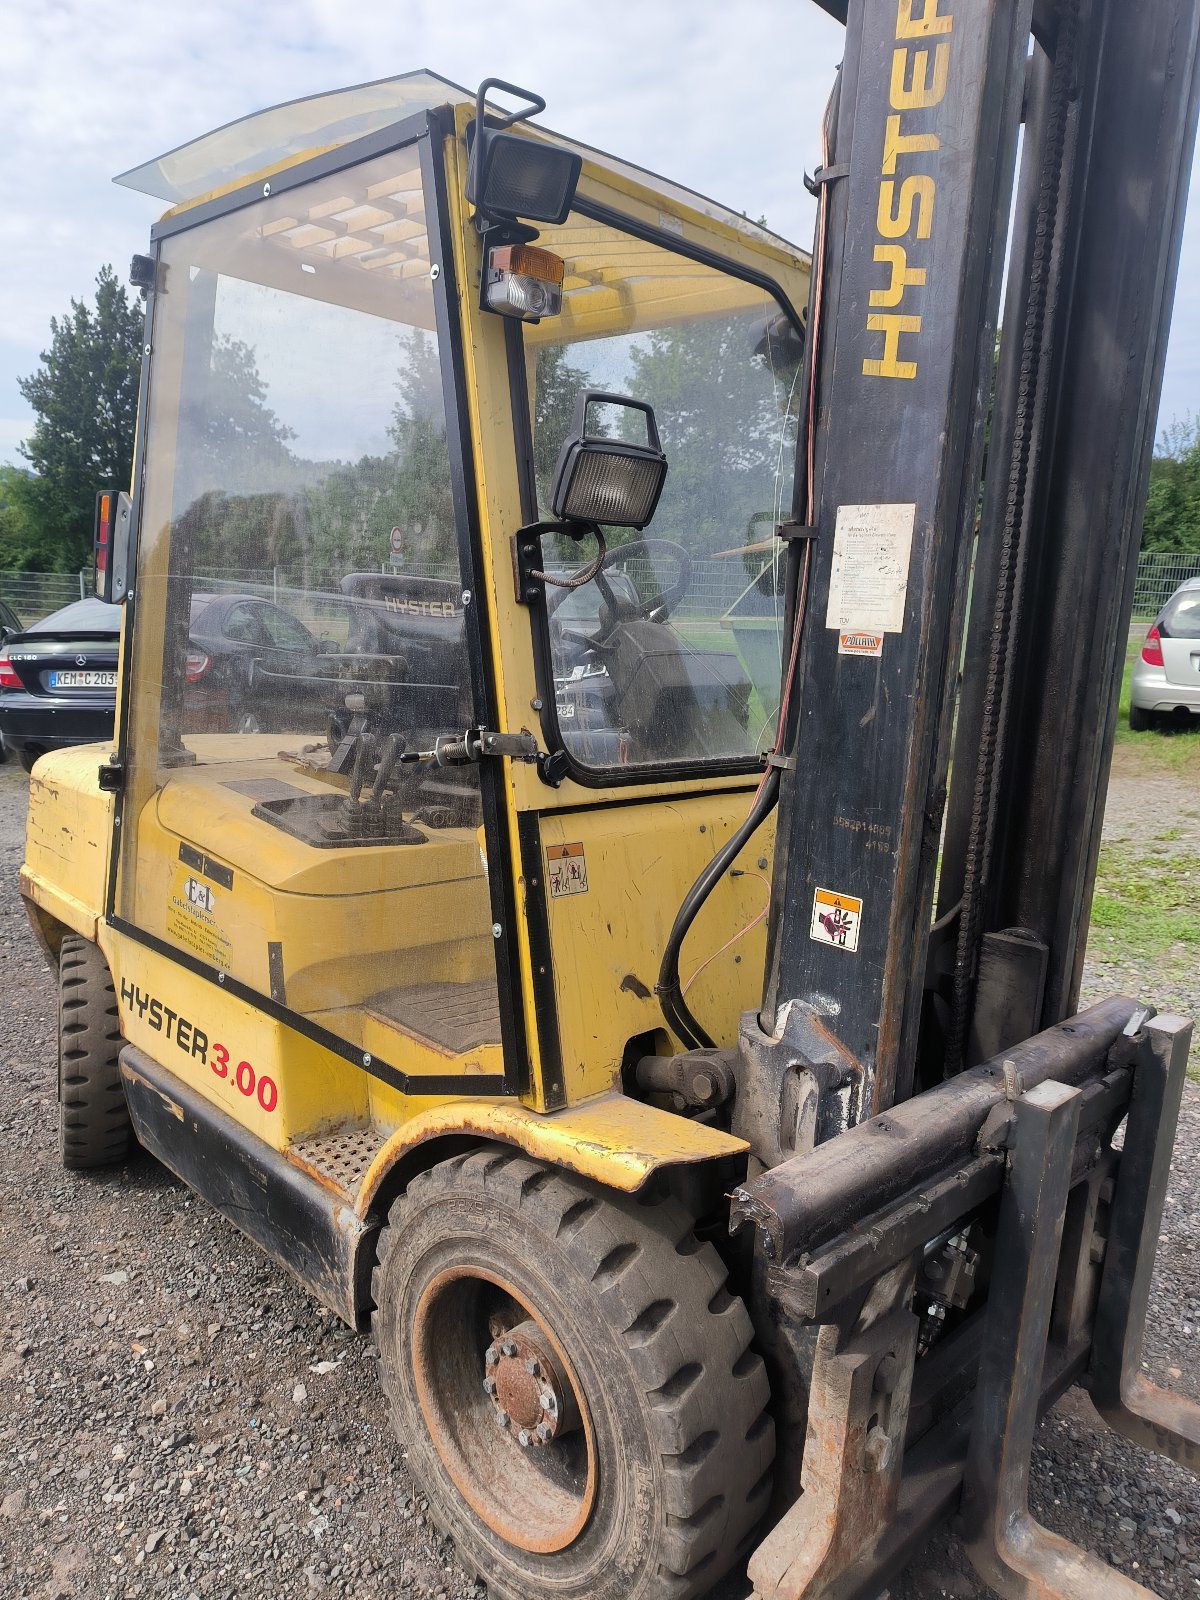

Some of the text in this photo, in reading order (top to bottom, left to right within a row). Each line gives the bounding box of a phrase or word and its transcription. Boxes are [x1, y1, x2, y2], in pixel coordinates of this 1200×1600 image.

[384, 595, 456, 618] HYSTER
[56, 672, 118, 685] KEM C 203
[120, 976, 278, 1113] HYSTER 3.00
